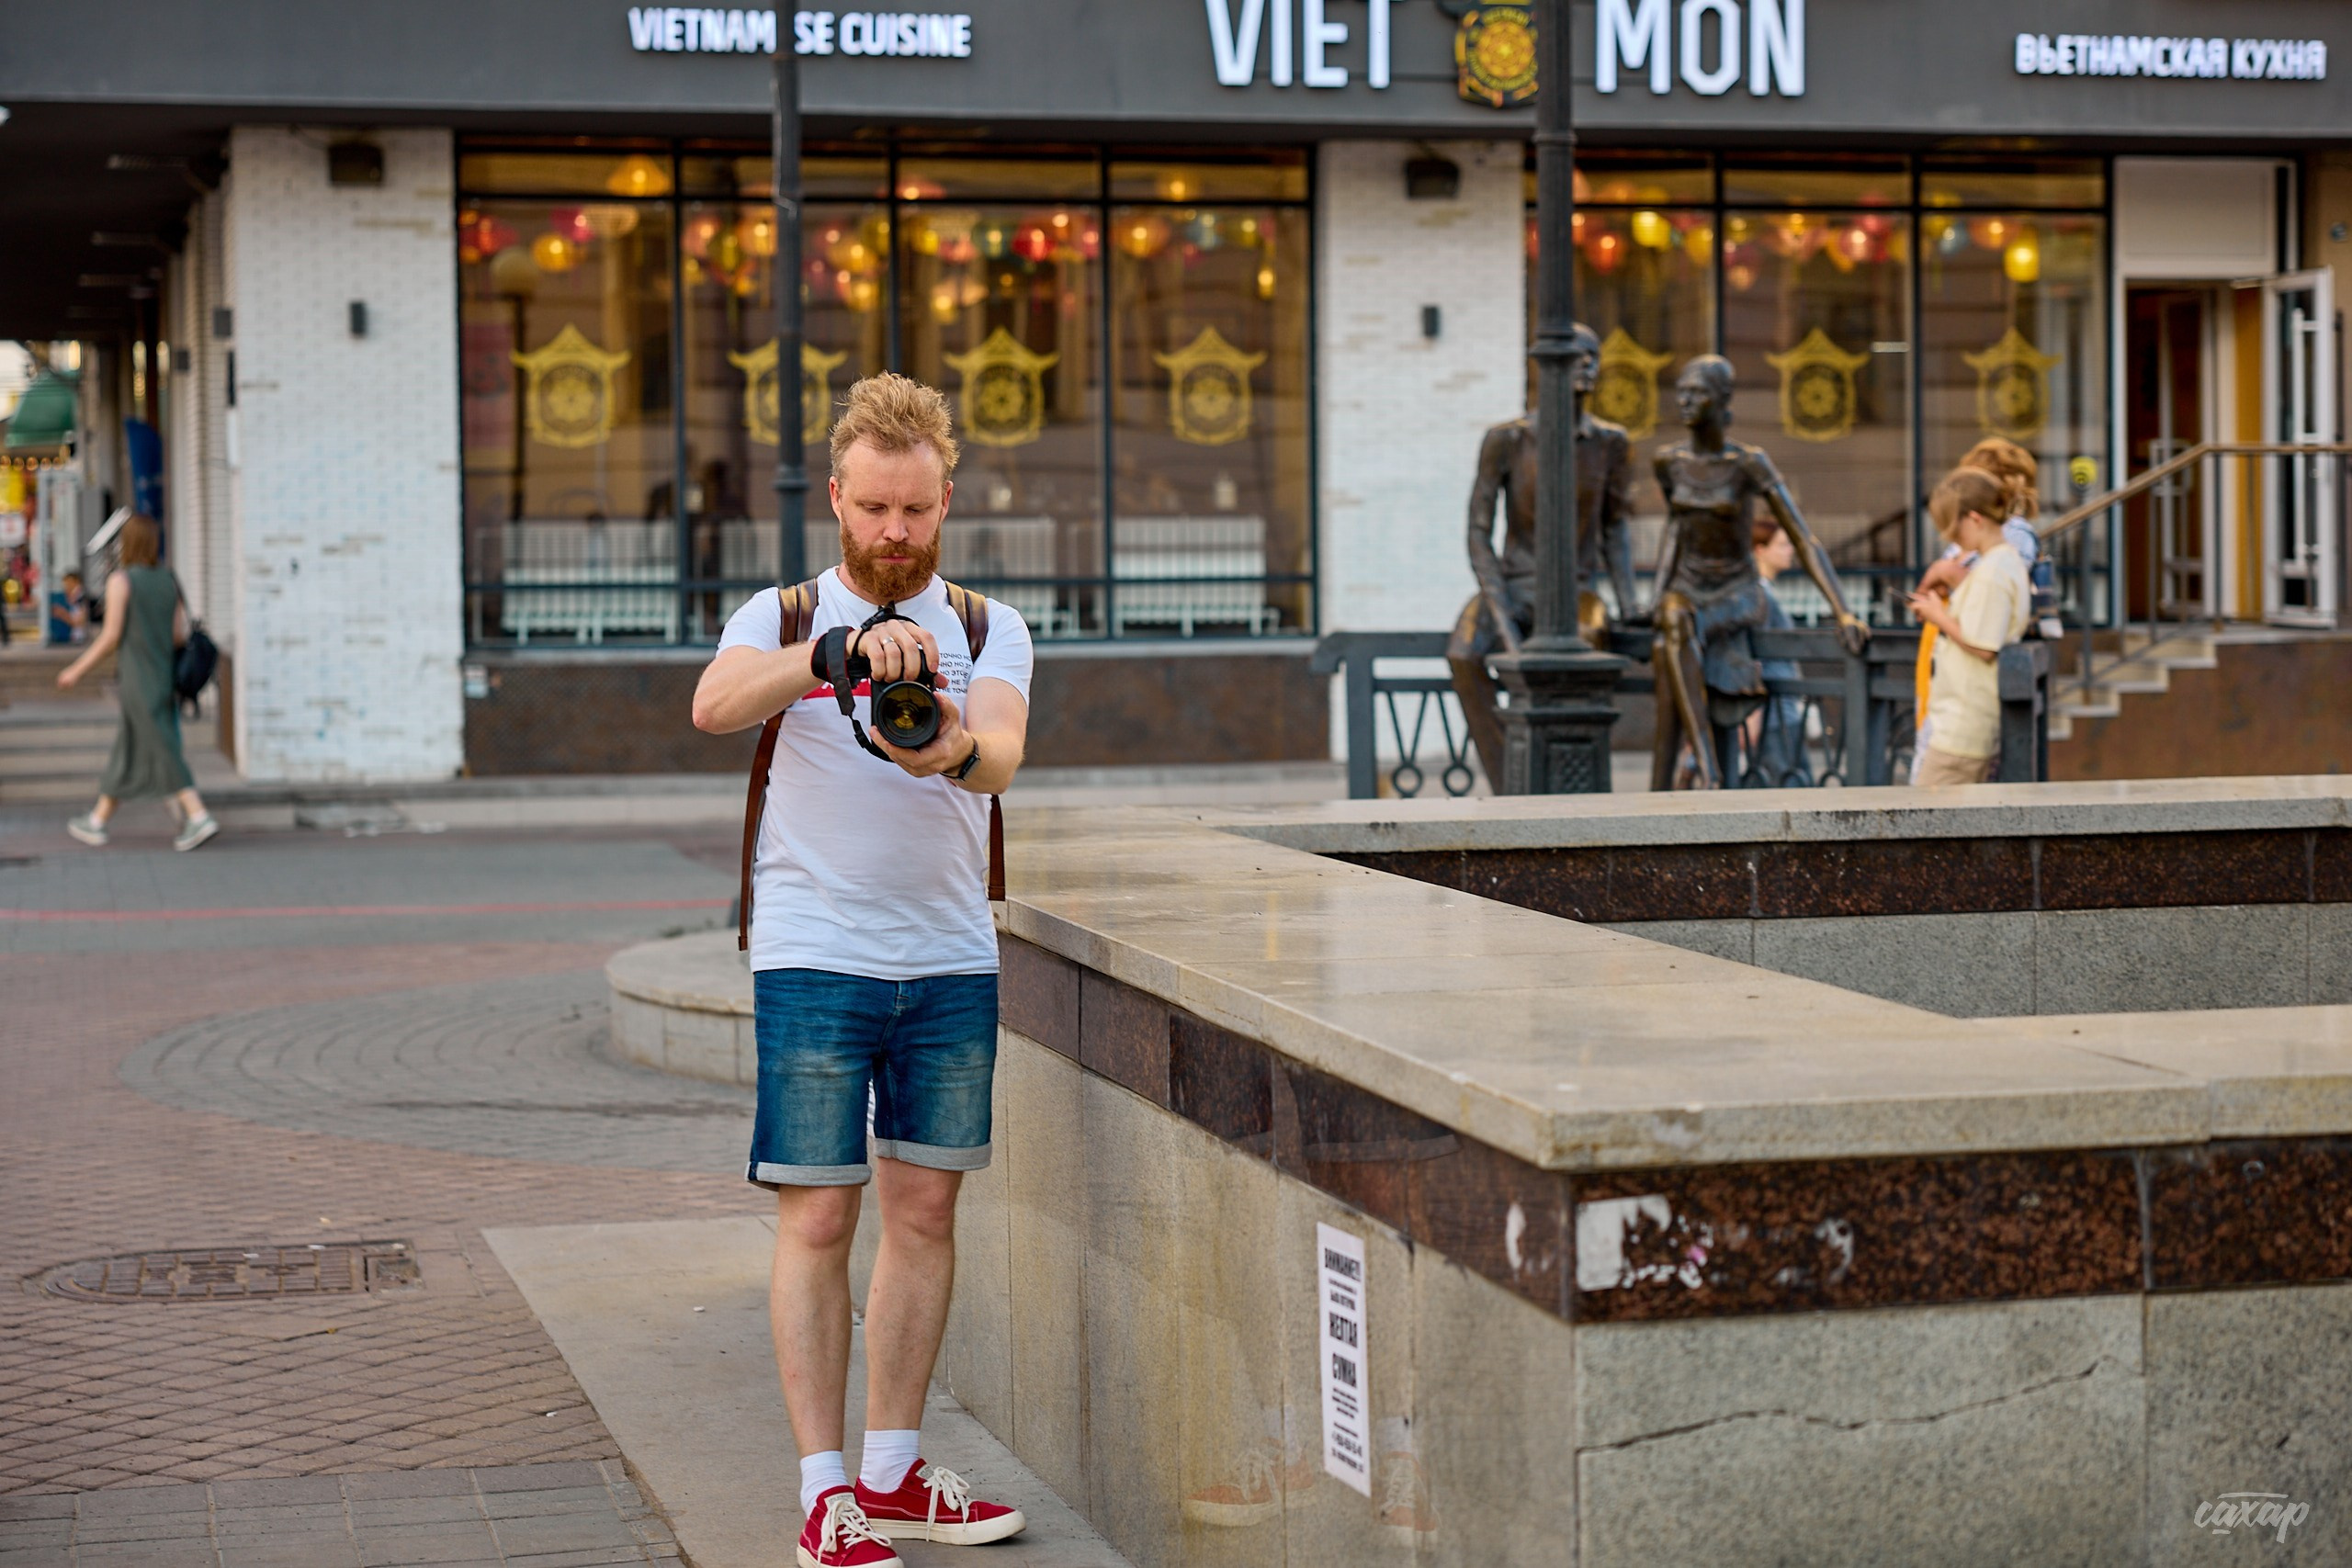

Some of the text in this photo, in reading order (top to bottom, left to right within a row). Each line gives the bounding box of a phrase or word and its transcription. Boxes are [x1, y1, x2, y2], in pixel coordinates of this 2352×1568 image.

[628, 7, 971, 57] VIETNAMSE CUISINE
[1596, 0, 1804, 96] MON
[2016, 33, 2327, 80] ВЬЕТНАМСКАЯ КУХНЯ
